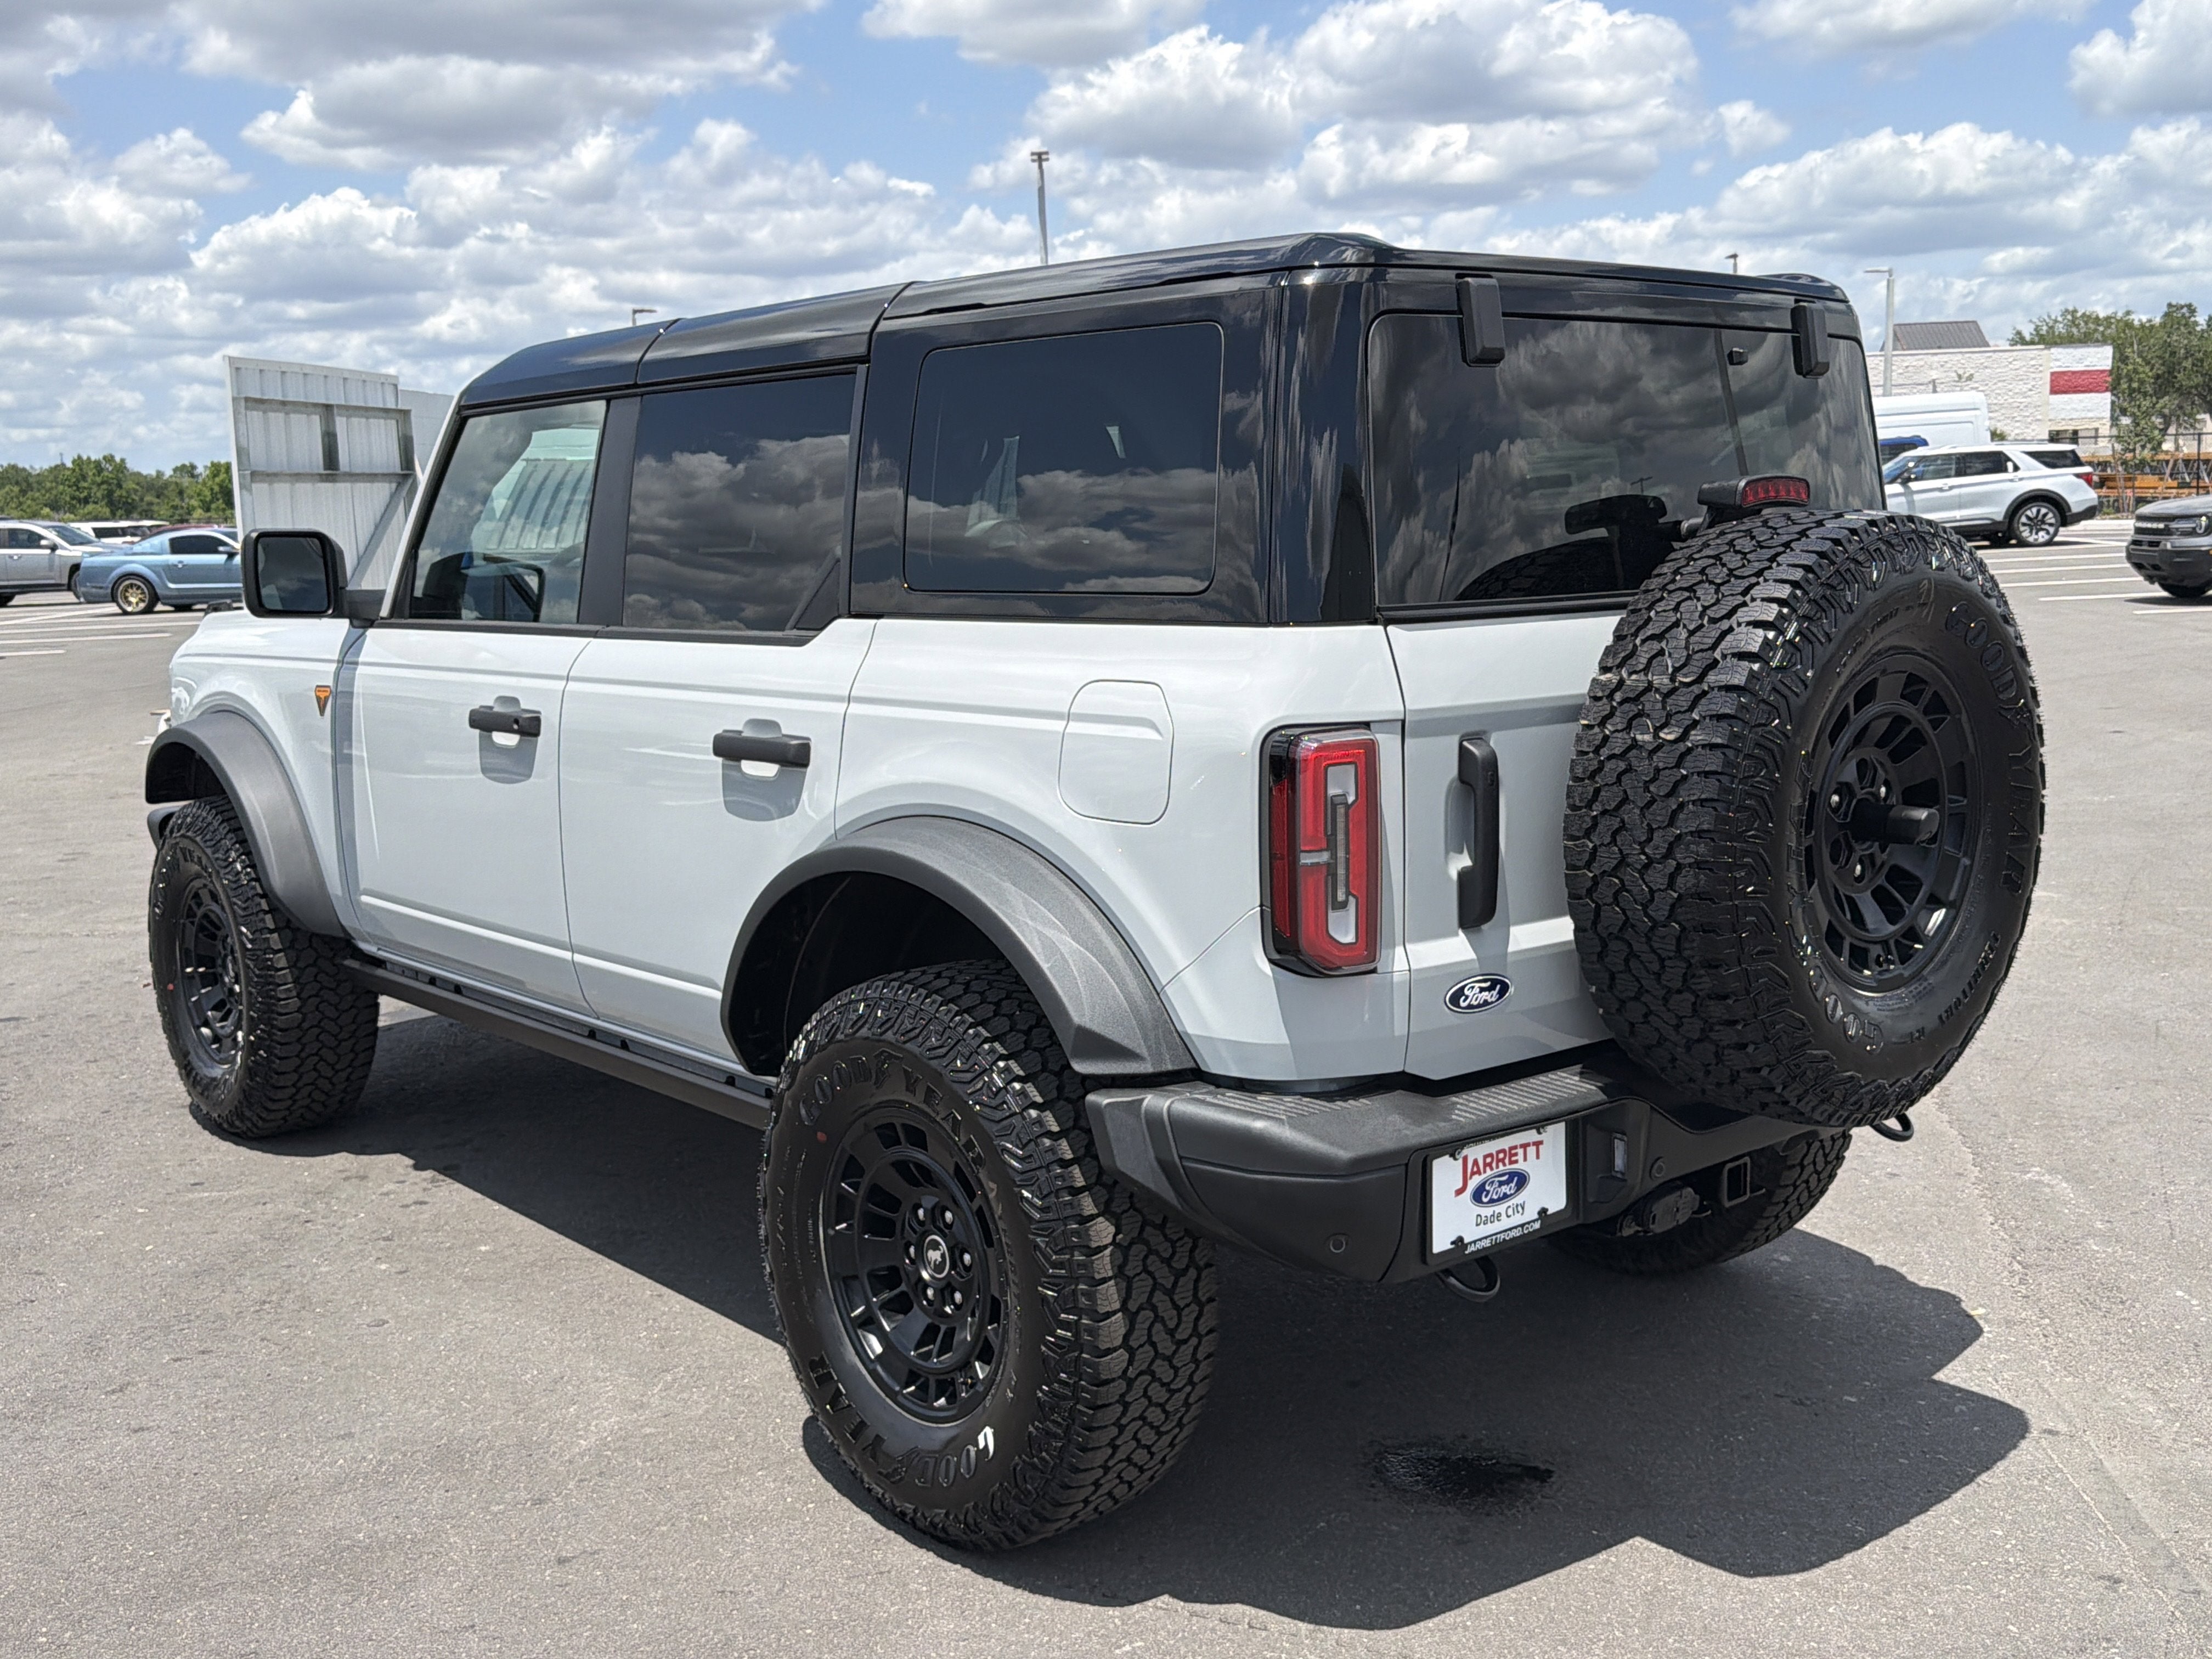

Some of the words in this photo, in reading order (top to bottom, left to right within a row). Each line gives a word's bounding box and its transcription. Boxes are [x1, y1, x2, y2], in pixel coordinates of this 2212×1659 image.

[1459, 981, 1501, 1007] Ford
[1454, 1140, 1544, 1197] JARRETT
[1482, 1175, 1517, 1203] Ford
[1475, 1210, 1502, 1227] Dade
[1505, 1201, 1526, 1218] City
[1464, 1220, 1541, 1254] JARRETTFORD.COM
